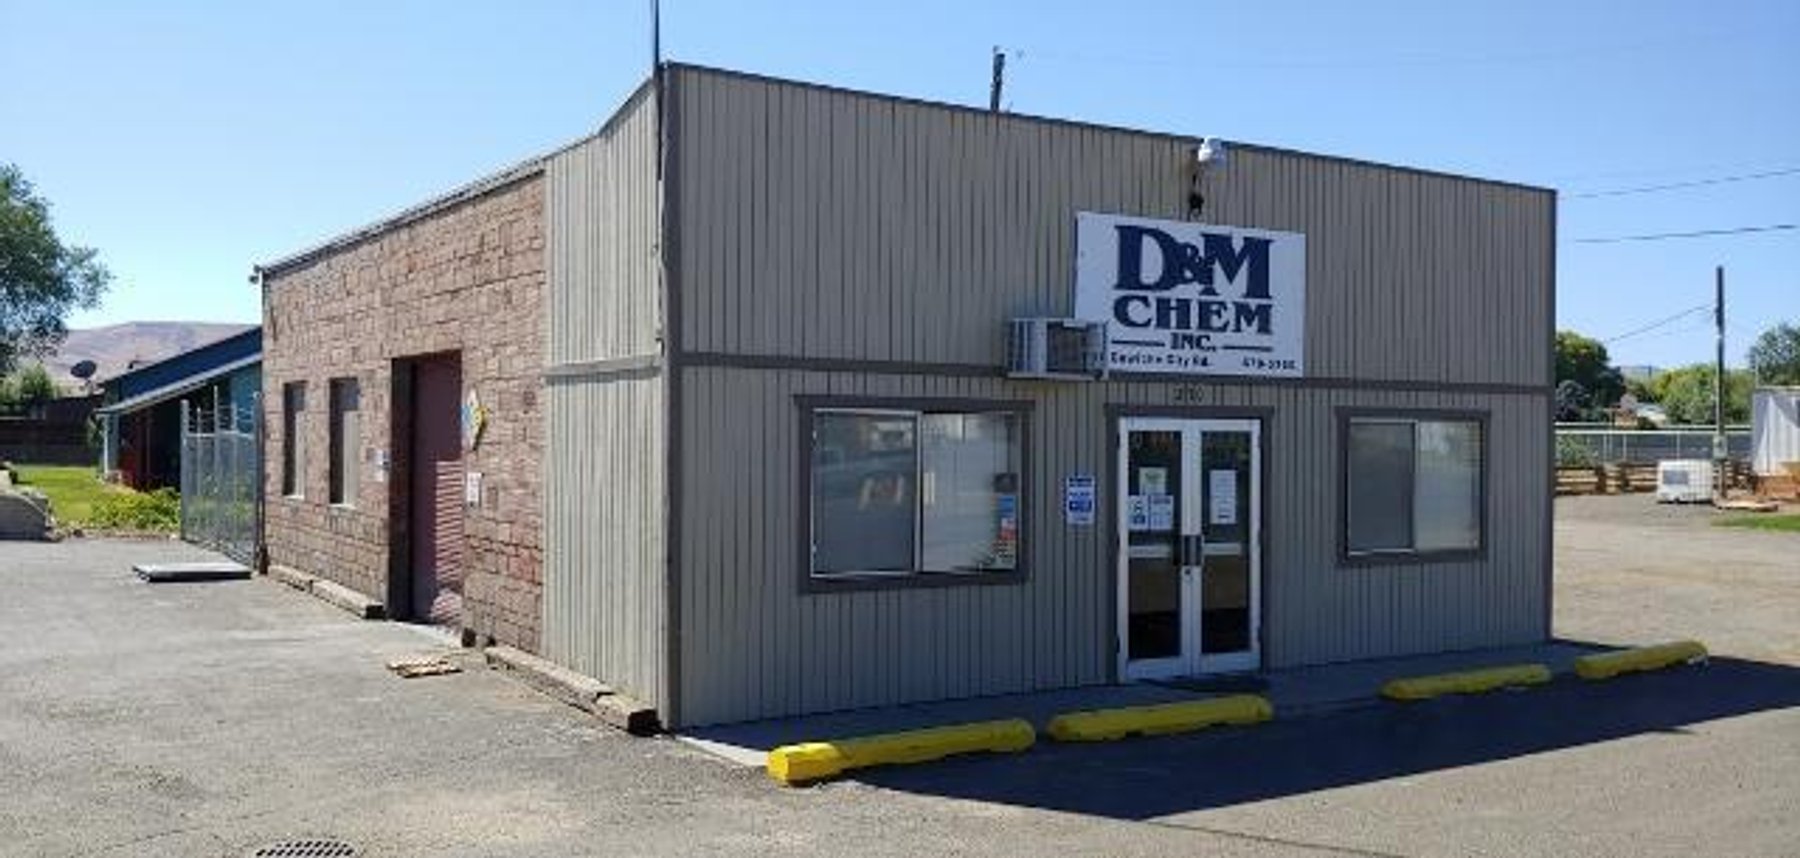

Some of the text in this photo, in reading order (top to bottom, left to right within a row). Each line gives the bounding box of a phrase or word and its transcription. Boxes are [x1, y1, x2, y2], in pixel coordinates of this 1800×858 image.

[1113, 224, 1275, 299] D&M
[1112, 295, 1274, 335] CHEM
[1170, 332, 1217, 352] INC.
